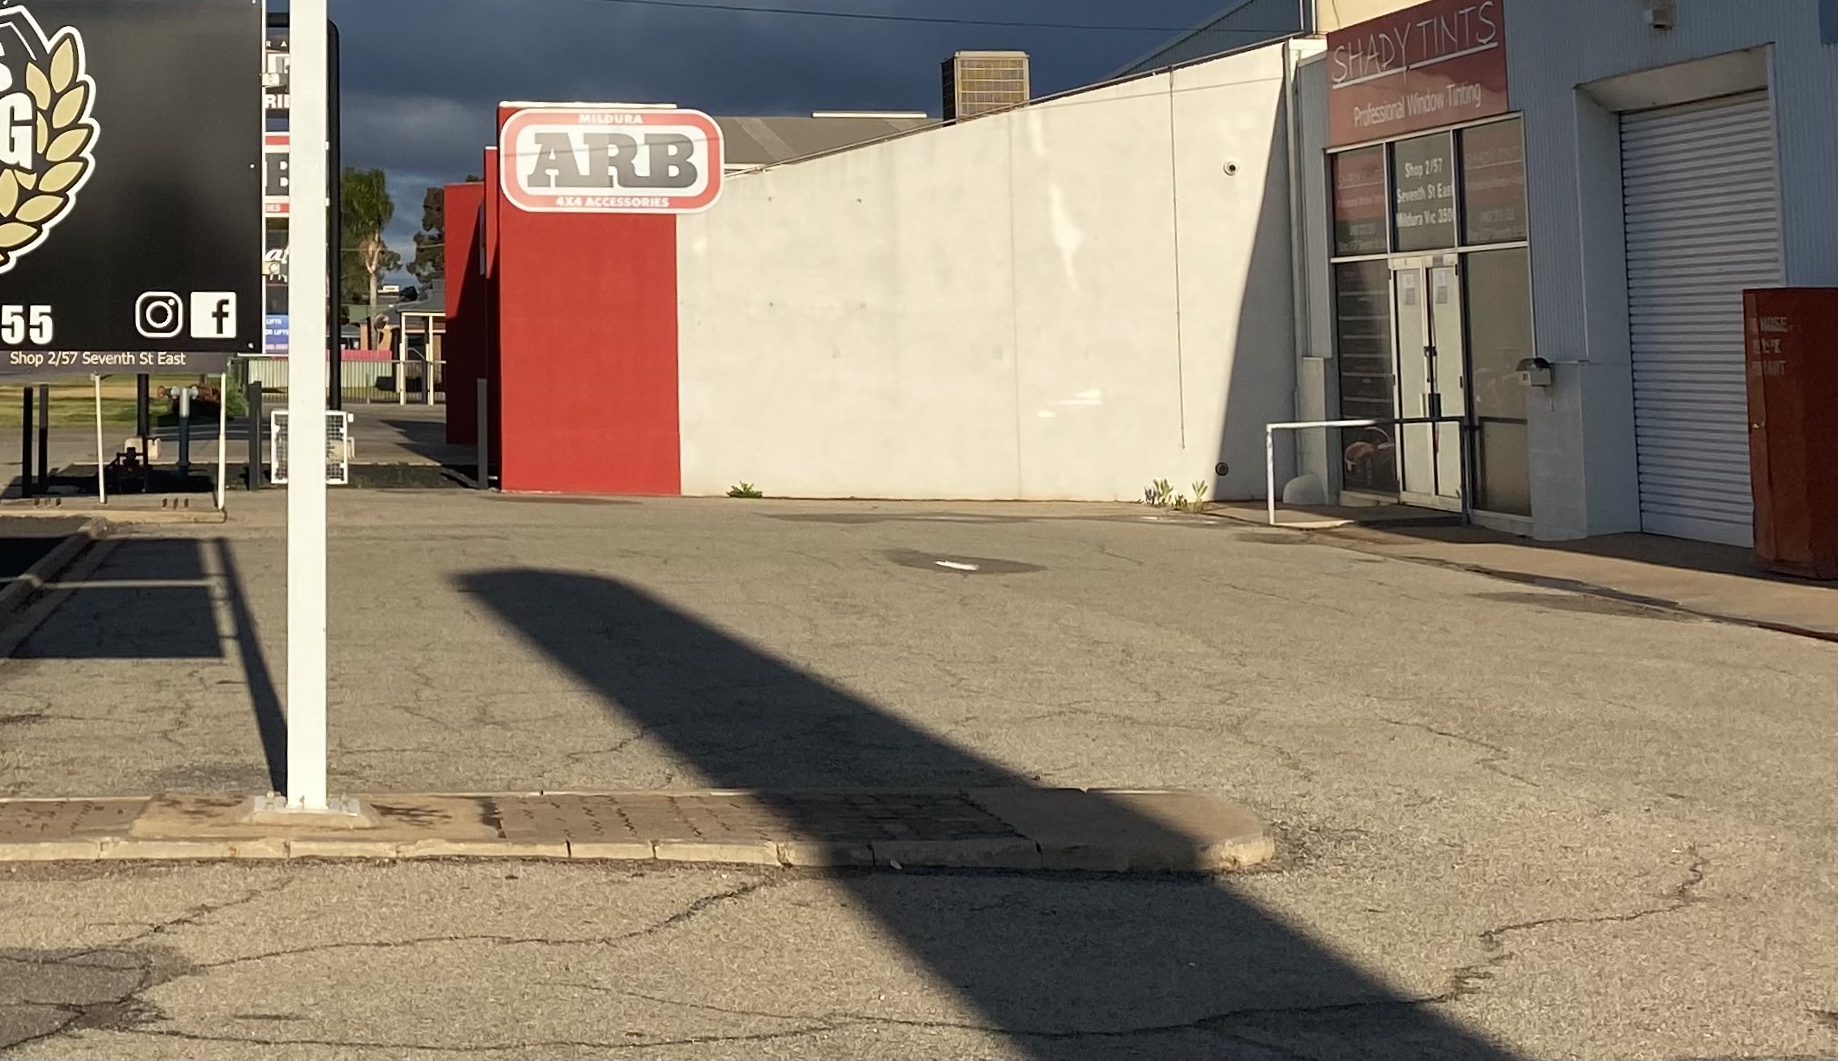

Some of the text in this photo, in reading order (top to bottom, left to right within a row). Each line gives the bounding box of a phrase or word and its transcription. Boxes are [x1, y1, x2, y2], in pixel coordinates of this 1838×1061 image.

[1331, 0, 1496, 86] SHADY TINTS
[1353, 83, 1482, 128] Professional Window Tinting
[578, 113, 643, 125] MILDURA
[527, 132, 698, 189] ARB
[1437, 182, 1453, 198] Eas
[556, 196, 670, 209] 4X4 ACCESSORIES
[10, 351, 187, 367] Shop 2/57 Seventh St East
